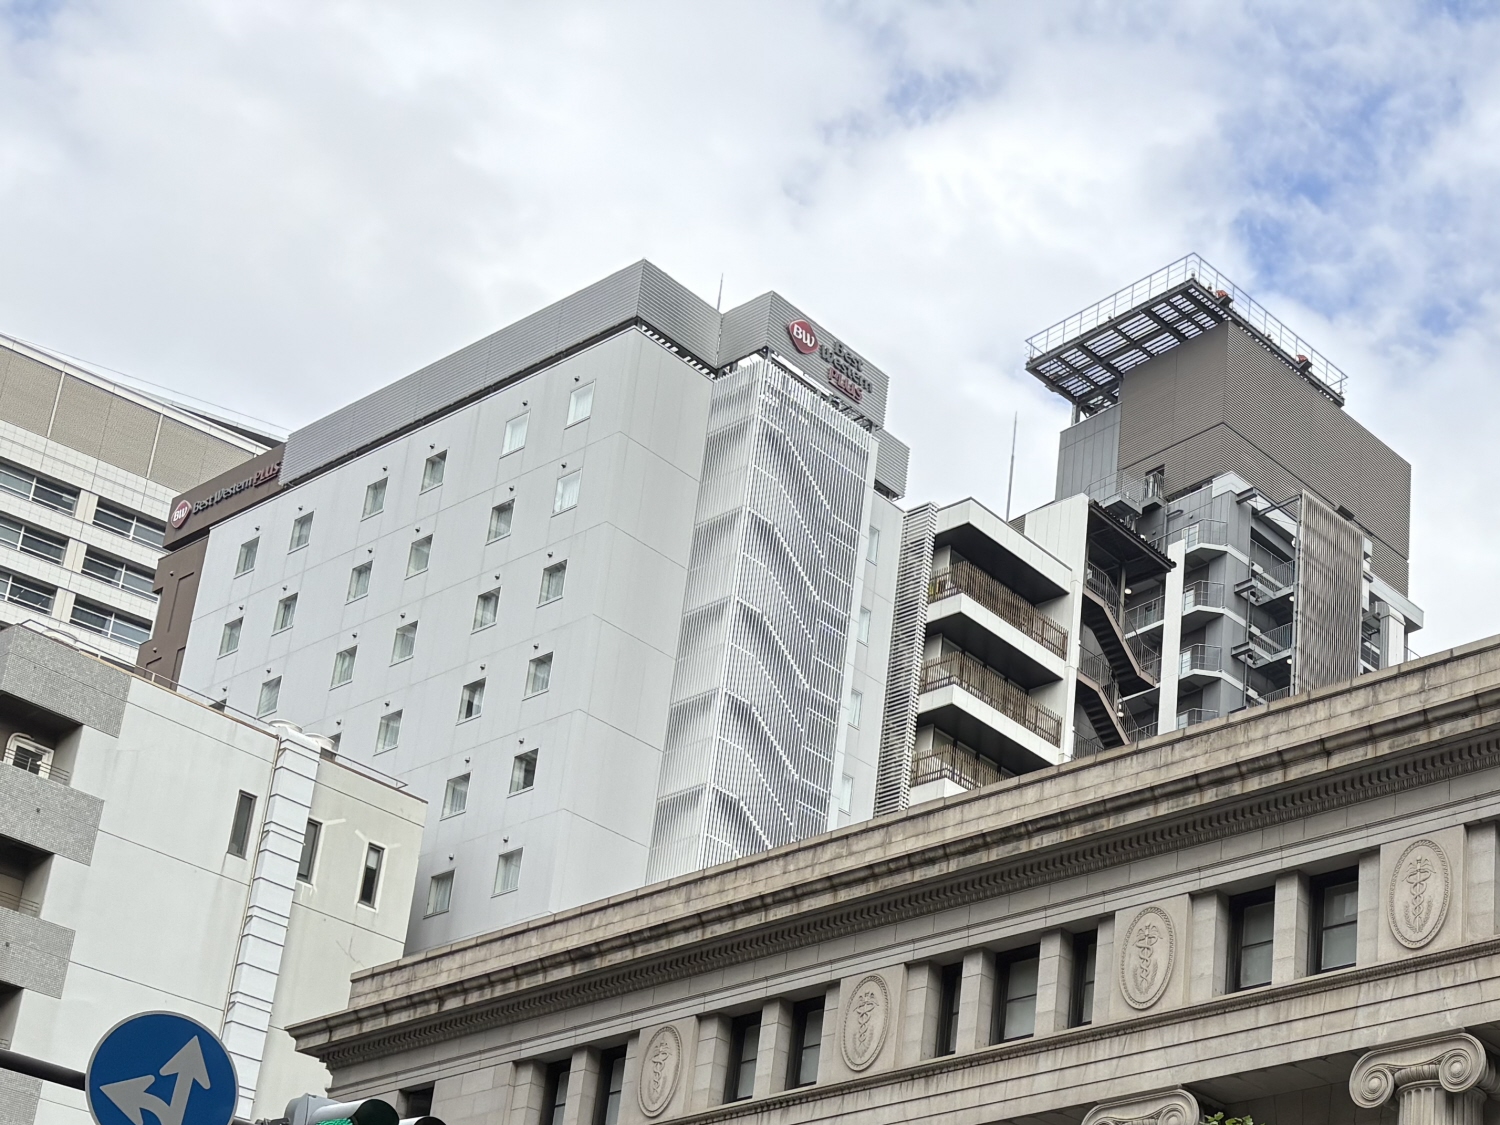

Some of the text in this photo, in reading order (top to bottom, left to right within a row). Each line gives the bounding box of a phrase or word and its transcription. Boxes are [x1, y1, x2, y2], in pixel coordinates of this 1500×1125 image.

[793, 323, 815, 348] BW
[820, 344, 873, 393] Western
[834, 340, 863, 372] Best
[828, 366, 862, 401] PLUS
[192, 462, 281, 514] Best Western PLUS
[172, 506, 188, 521] BW
